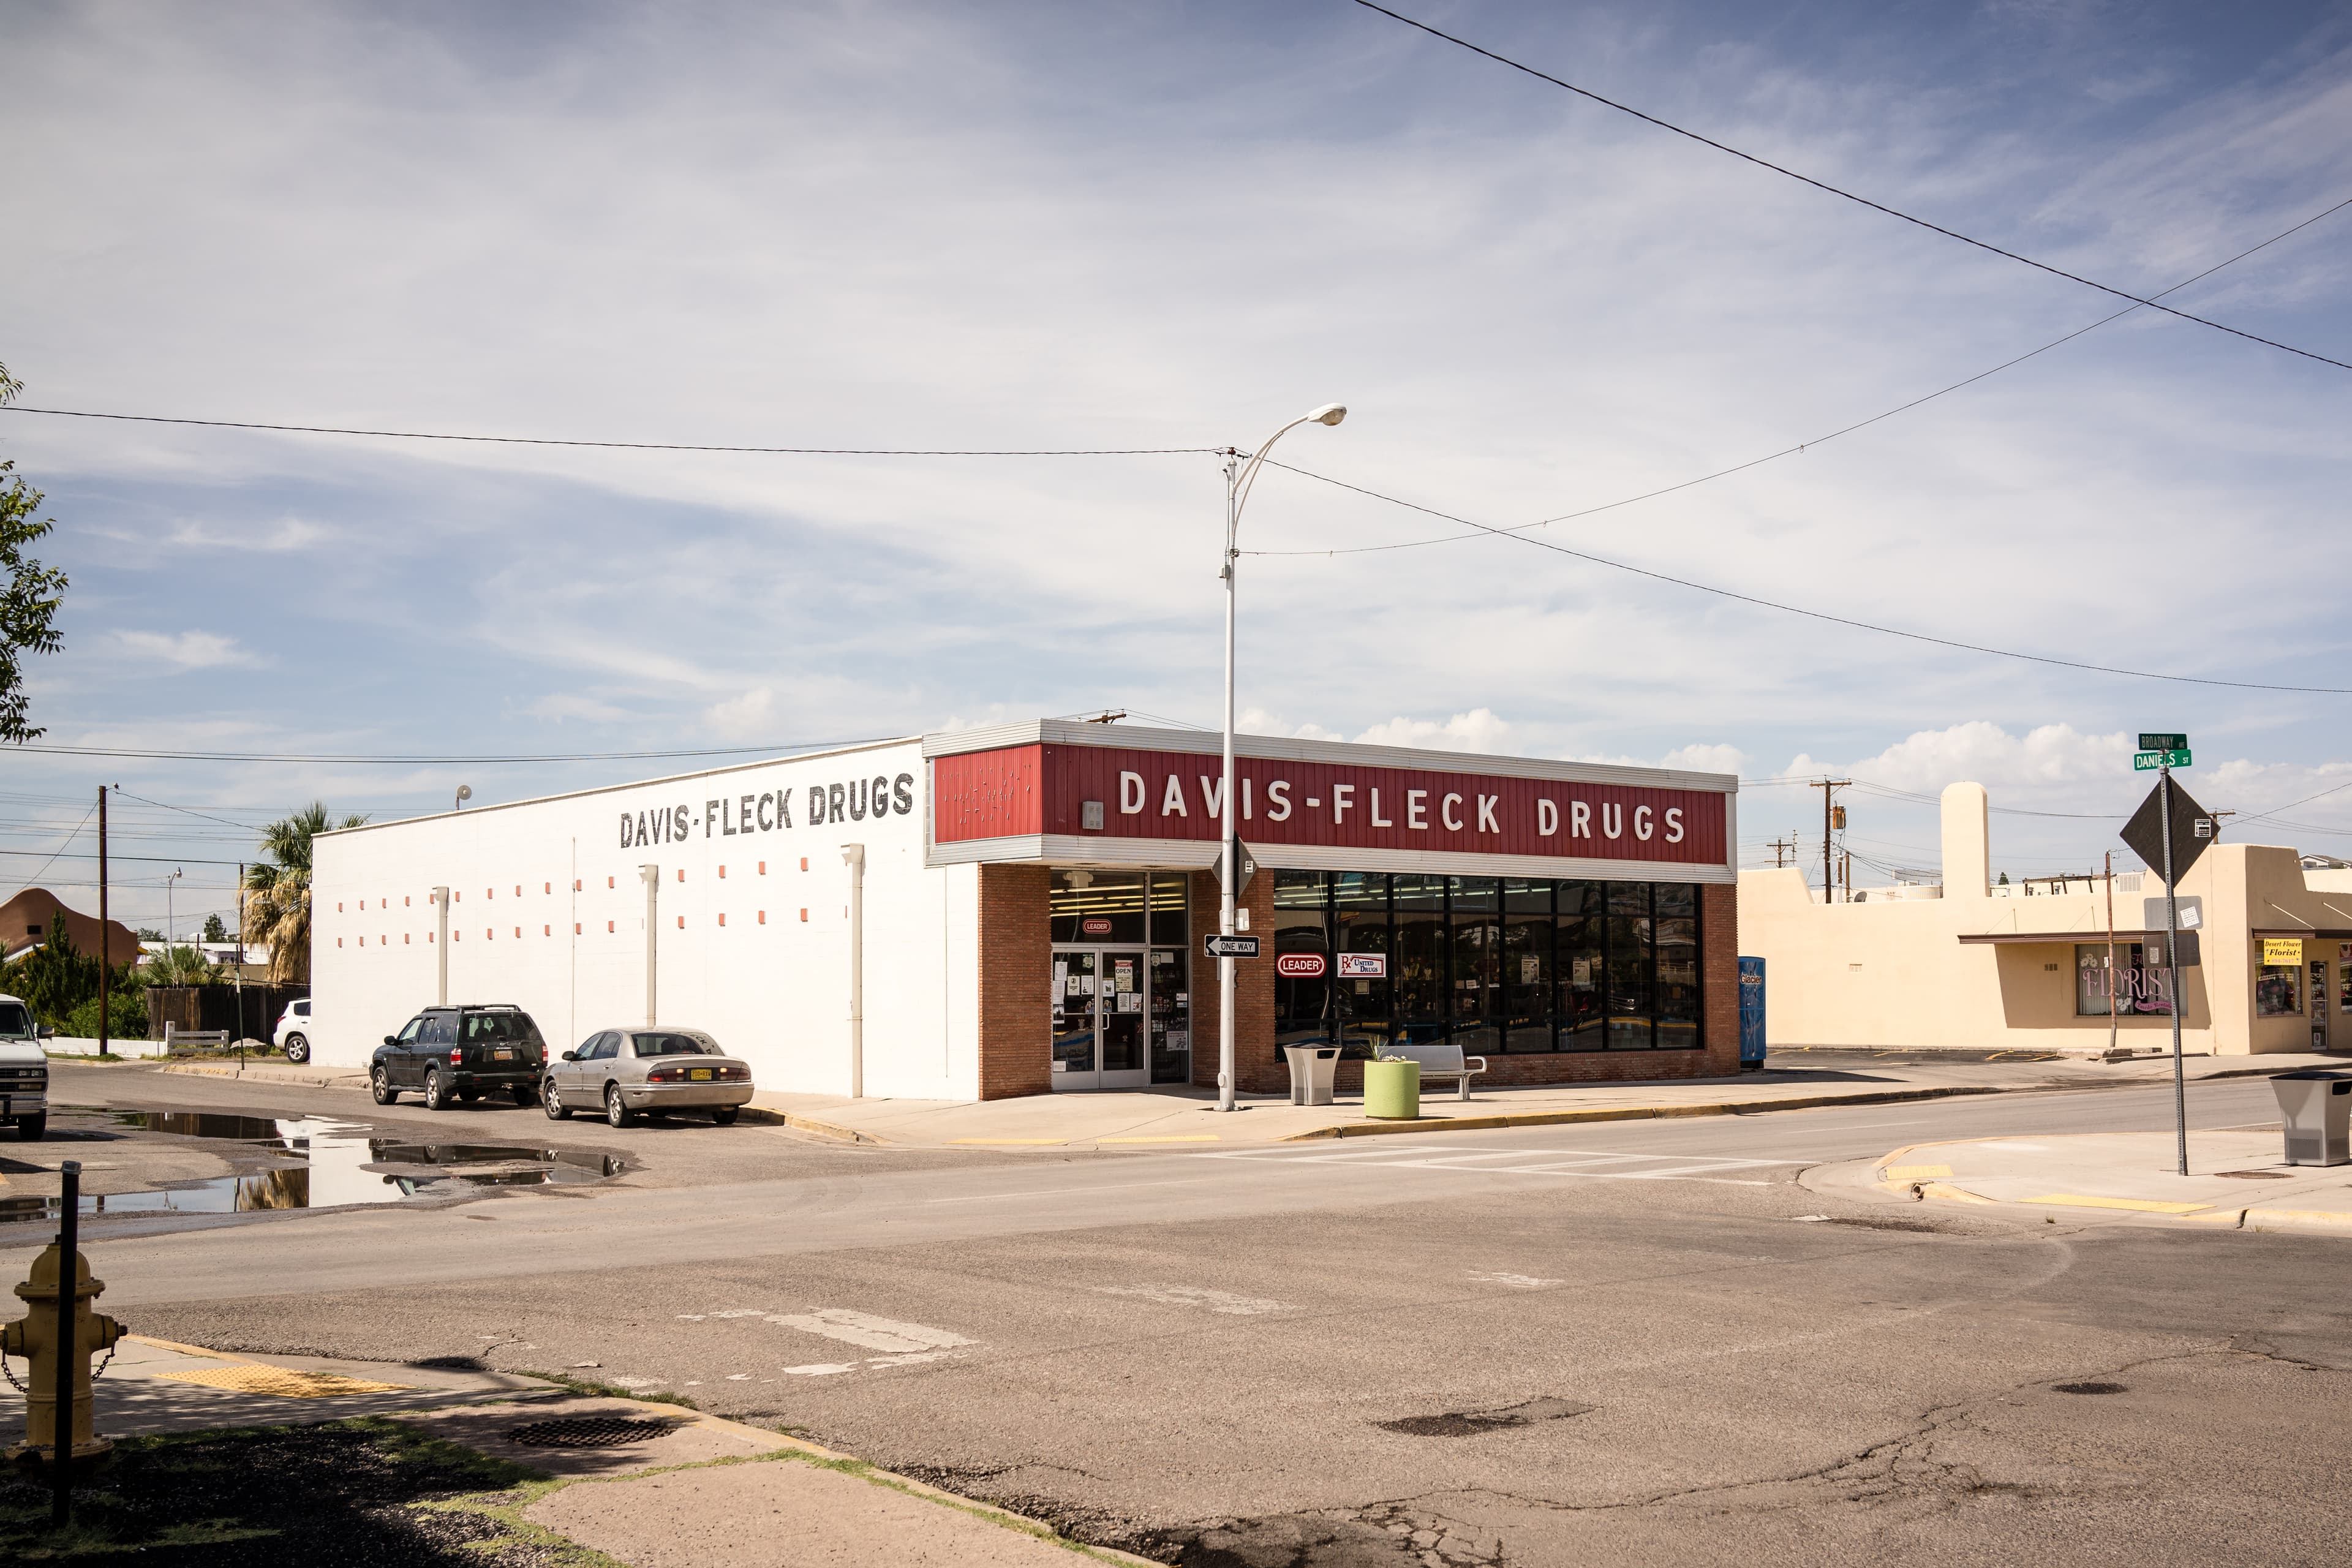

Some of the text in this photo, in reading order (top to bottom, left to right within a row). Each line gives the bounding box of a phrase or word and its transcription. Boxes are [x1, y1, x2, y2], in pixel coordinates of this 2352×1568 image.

[2141, 736, 2173, 748] BROADWAY
[620, 772, 914, 848] DAVIS-FLECK DRUGS
[1120, 770, 1684, 843] DAVIS-FLECK DRUGS
[1221, 942, 1253, 951] ONE WAY
[1740, 974, 1762, 984] Glacier
